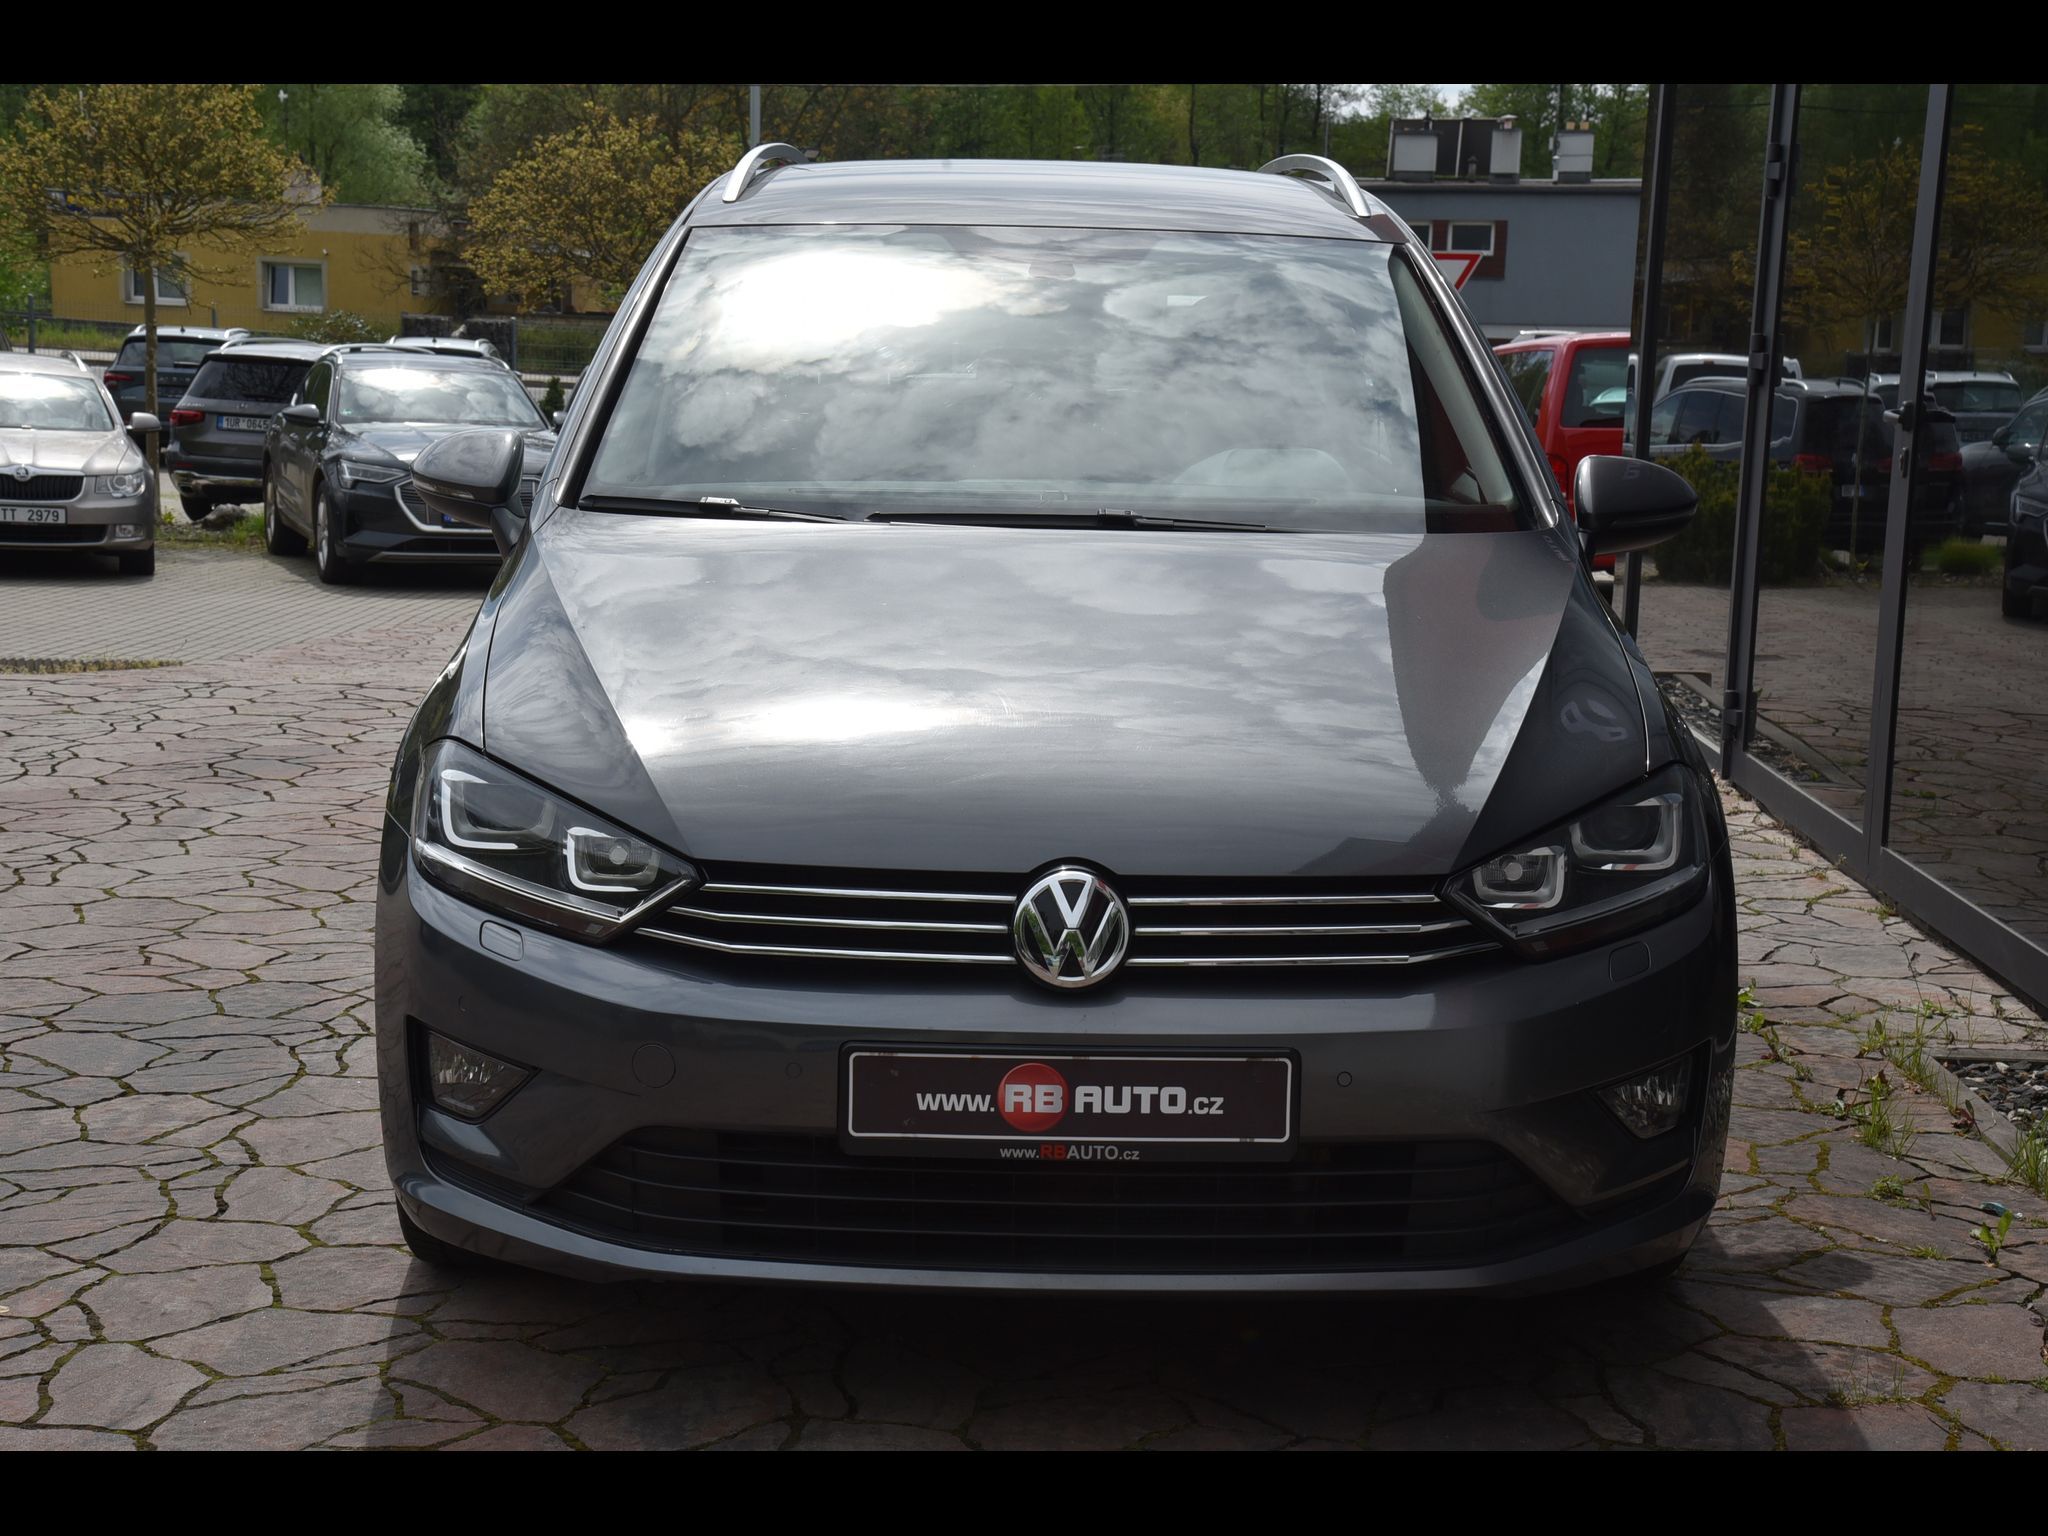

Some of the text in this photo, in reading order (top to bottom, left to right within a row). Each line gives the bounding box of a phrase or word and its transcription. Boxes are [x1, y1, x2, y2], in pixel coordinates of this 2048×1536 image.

[27, 509, 59, 521] 2979
[1004, 1084, 1063, 1113] RB
[1000, 1145, 1140, 1160] www.RBAUTO.cz
